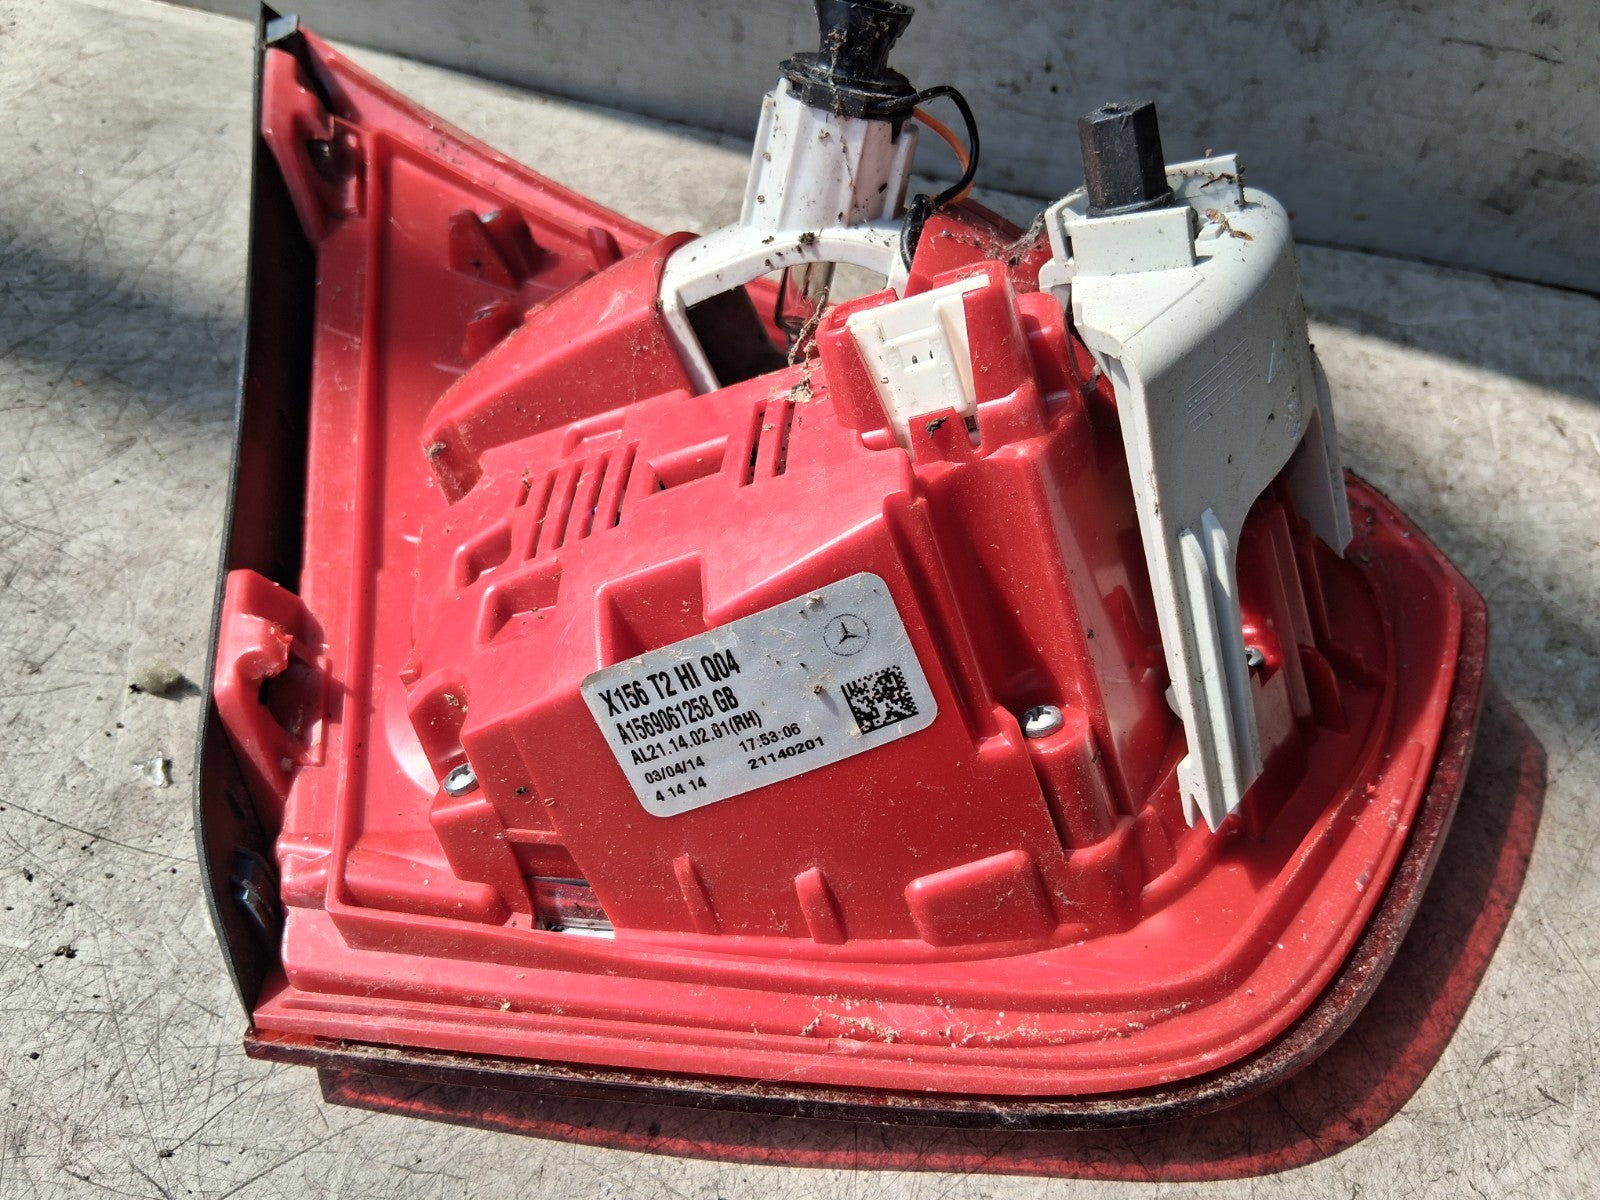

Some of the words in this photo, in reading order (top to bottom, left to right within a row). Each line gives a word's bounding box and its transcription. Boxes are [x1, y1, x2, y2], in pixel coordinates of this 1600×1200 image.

[598, 681, 649, 717] X156
[646, 671, 678, 700] T2
[673, 662, 701, 691] HI
[701, 650, 740, 682] Q04
[616, 695, 714, 745] A1569061258
[712, 686, 739, 712] GB
[631, 709, 762, 765] AL21.14.02.01(RH)
[739, 722, 801, 752] 17:53:06
[747, 736, 825, 770] 21140201
[644, 756, 706, 784] 03/04/14
[656, 790, 664, 801] 4
[667, 784, 685, 798] 14
[688, 777, 707, 792] 14
